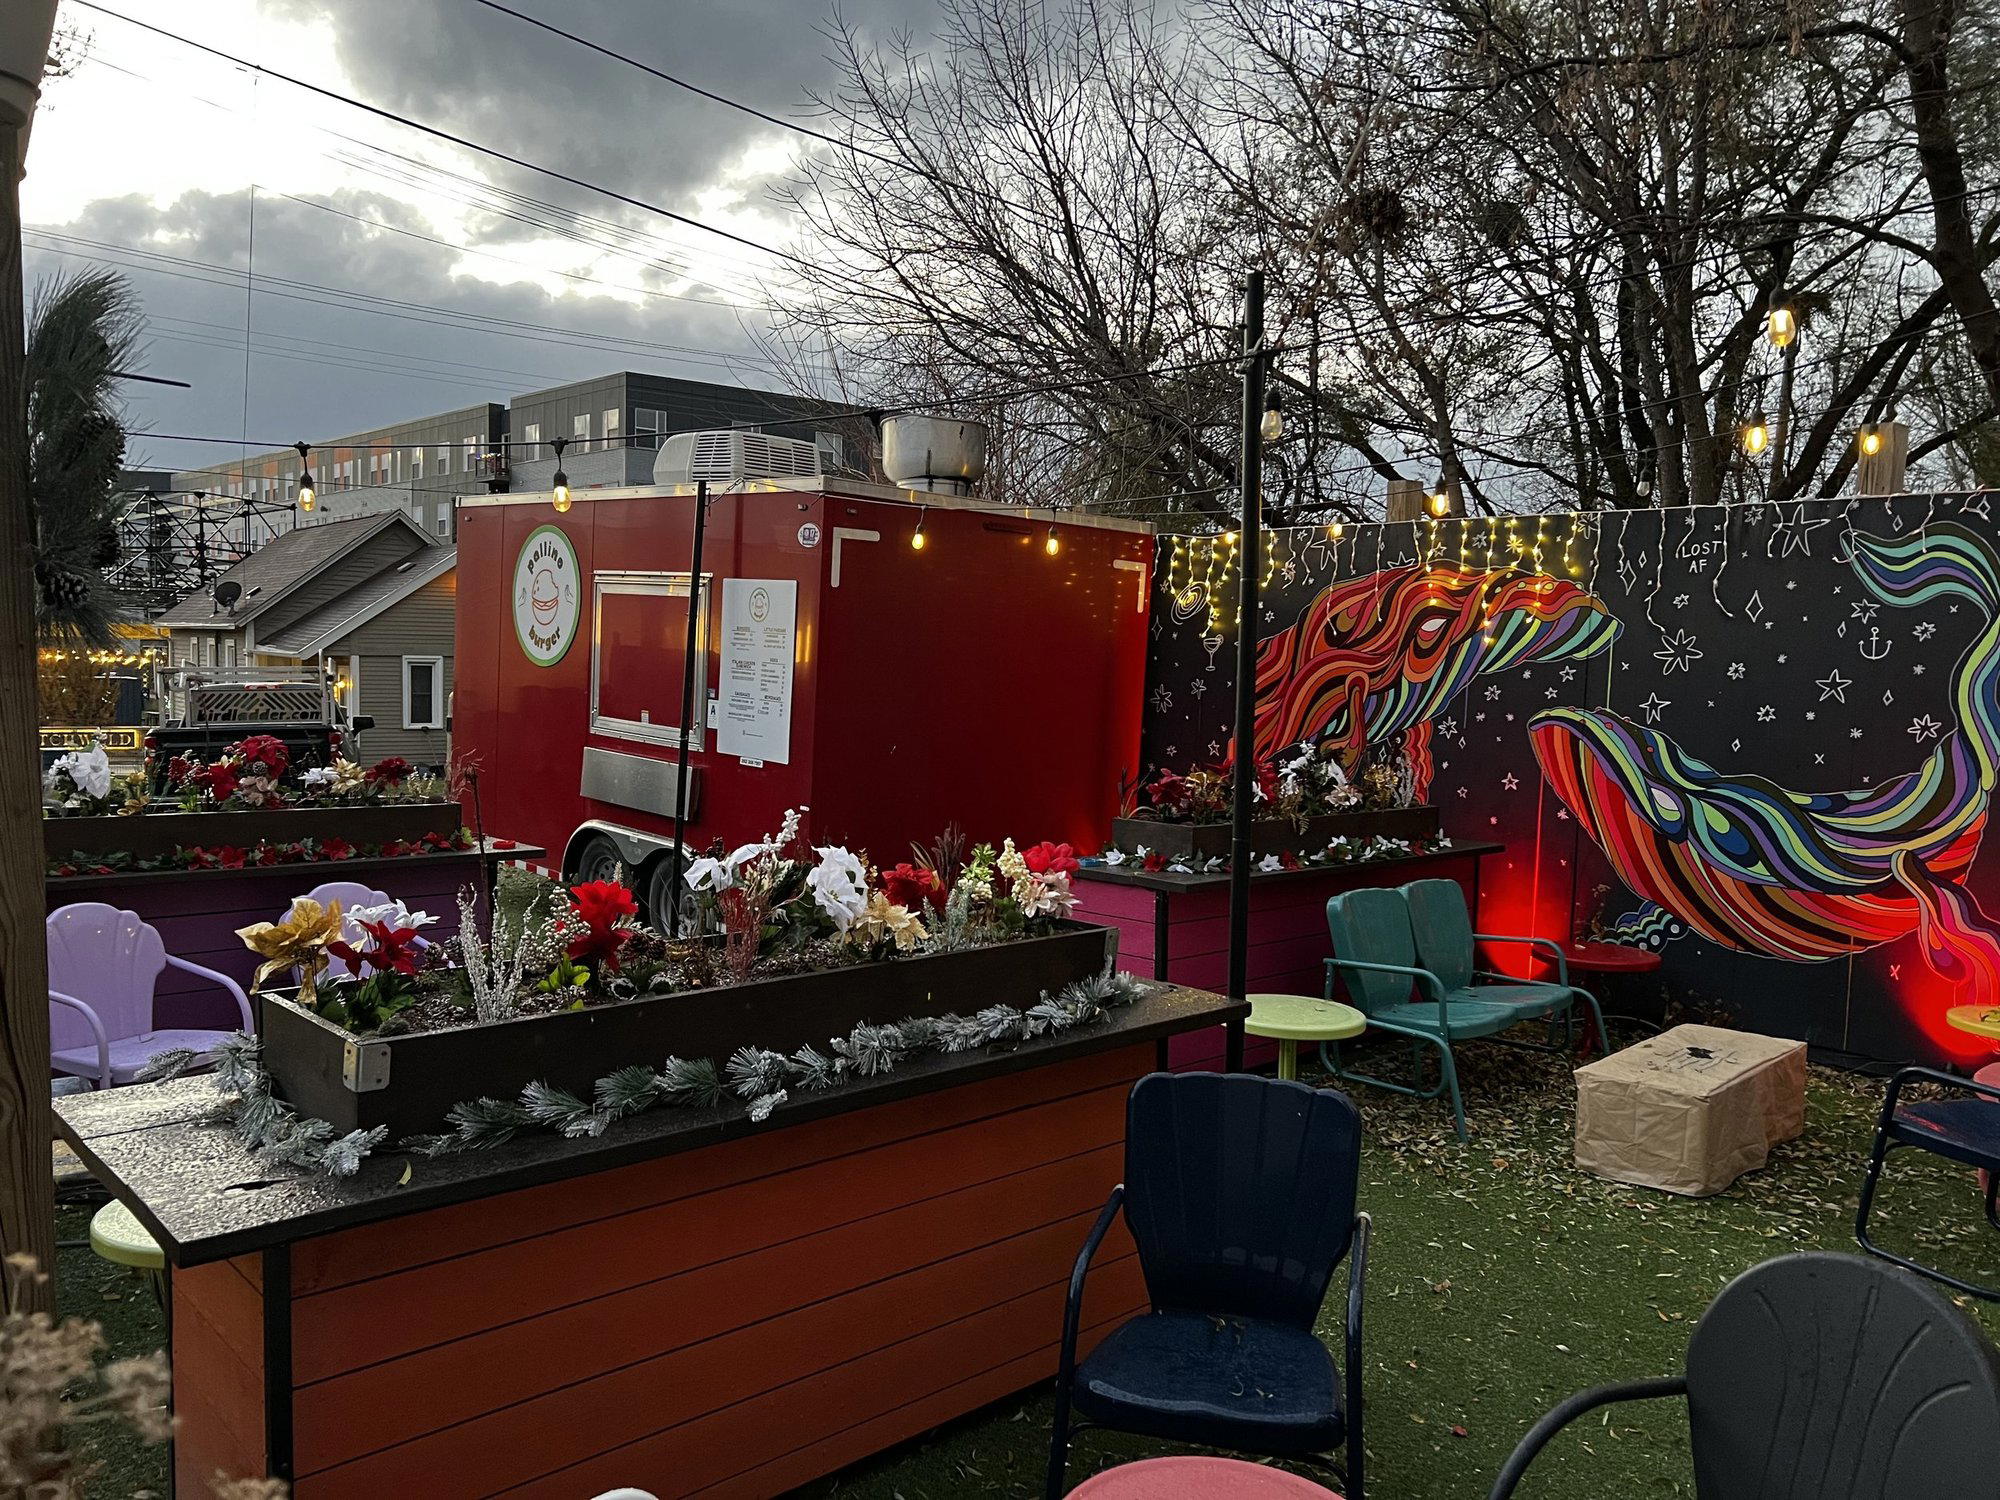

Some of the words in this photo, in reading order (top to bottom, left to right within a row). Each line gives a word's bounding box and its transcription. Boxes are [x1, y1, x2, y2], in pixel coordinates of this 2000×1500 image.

[527, 541, 564, 574] pallino
[1682, 540, 1722, 558] LOST
[1688, 559, 1707, 573] AF
[528, 625, 561, 651] burger
